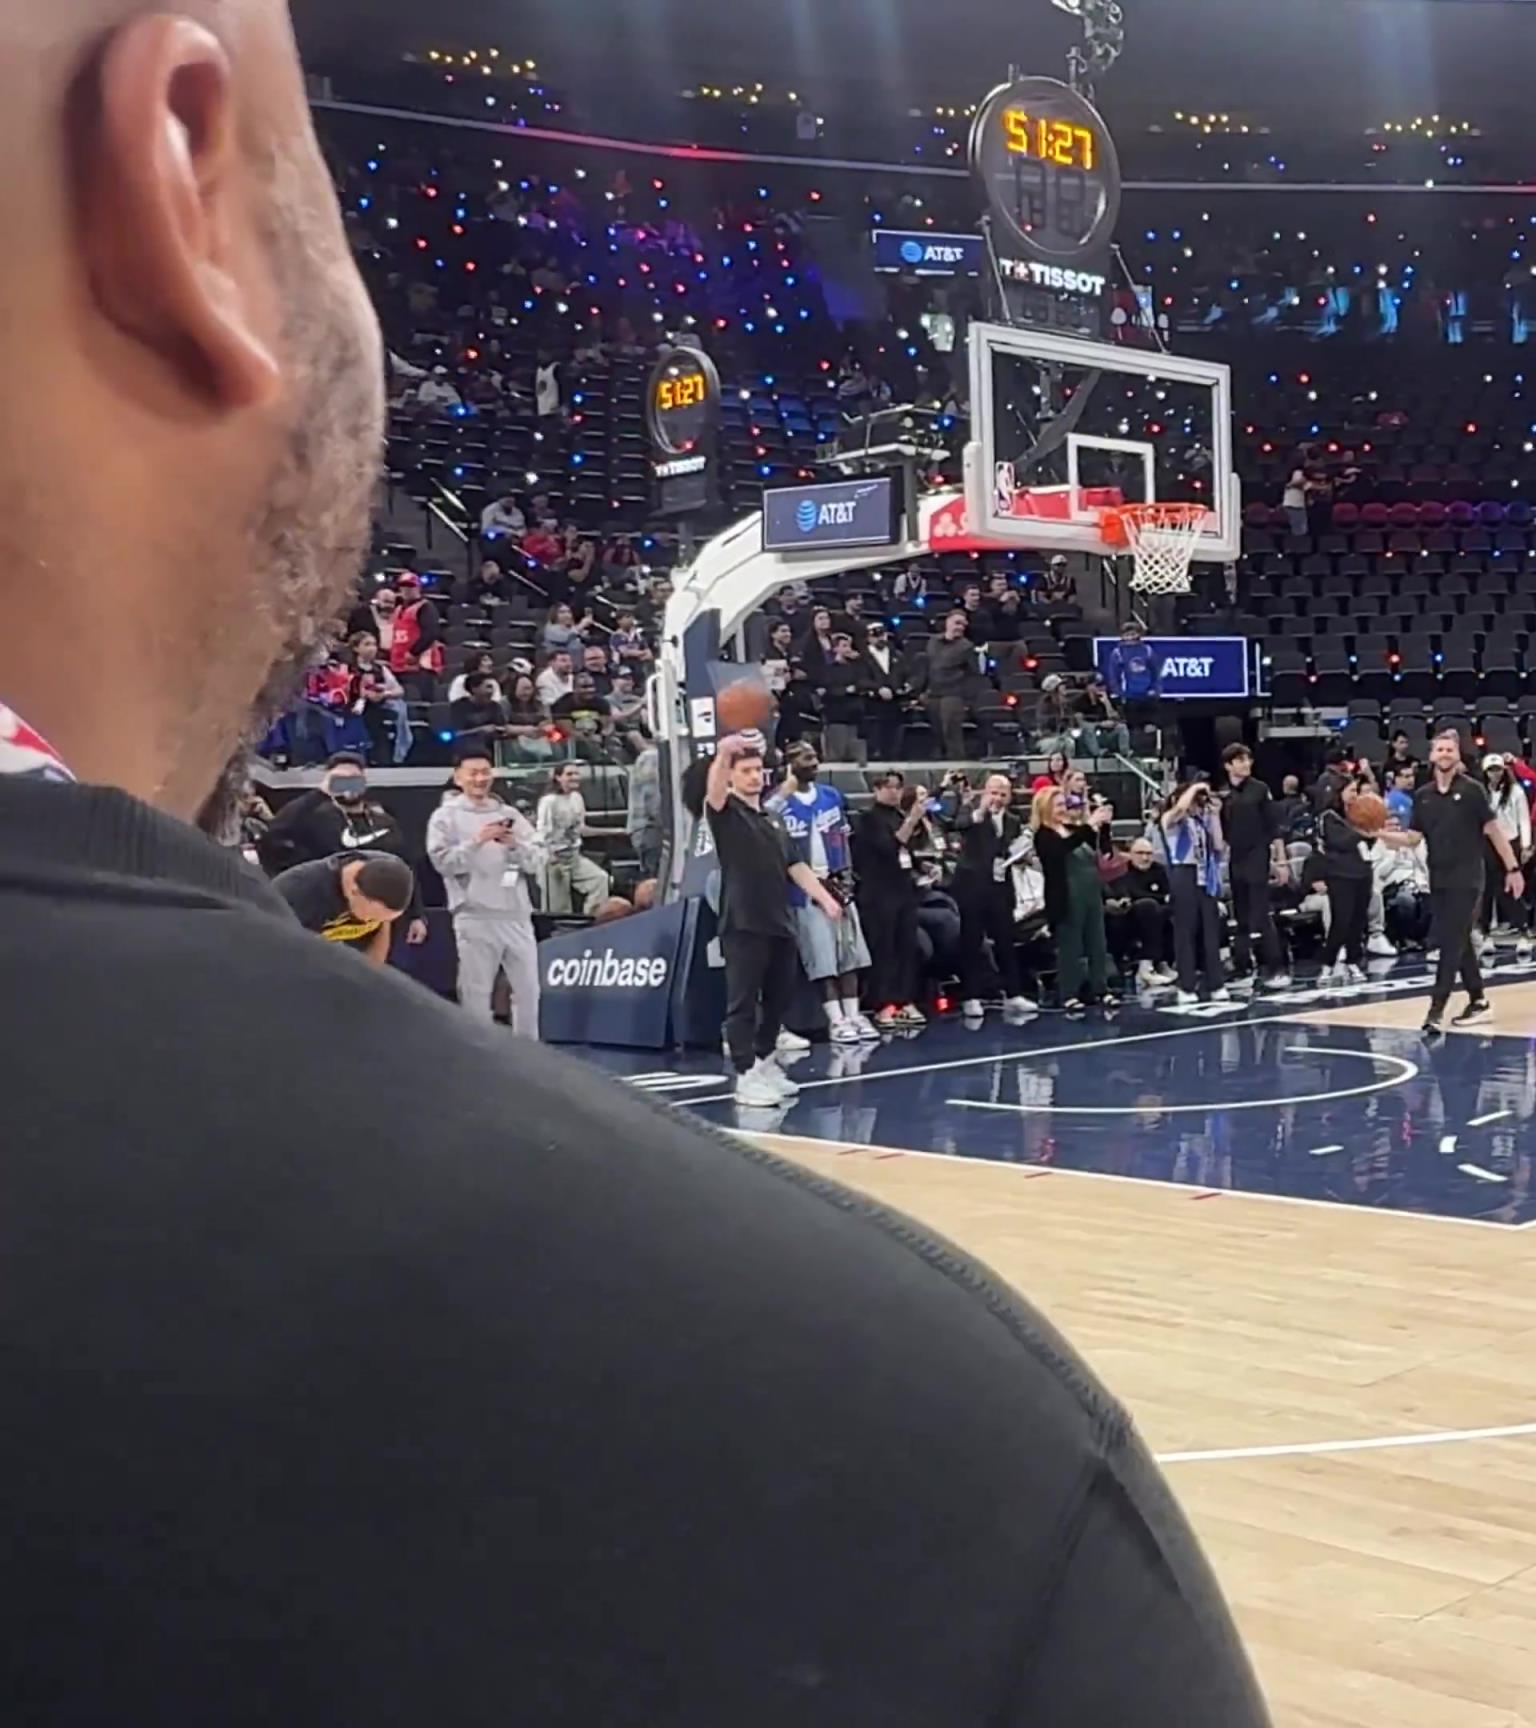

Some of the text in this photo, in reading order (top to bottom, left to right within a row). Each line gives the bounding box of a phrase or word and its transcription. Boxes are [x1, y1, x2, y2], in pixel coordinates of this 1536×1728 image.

[1005, 107, 1093, 170] 51:27
[924, 245, 964, 262] AT&T
[1029, 262, 1105, 296] TISSOT
[818, 501, 856, 525] AT&T
[1160, 656, 1215, 677] AT&T
[547, 948, 667, 988] coinbase
